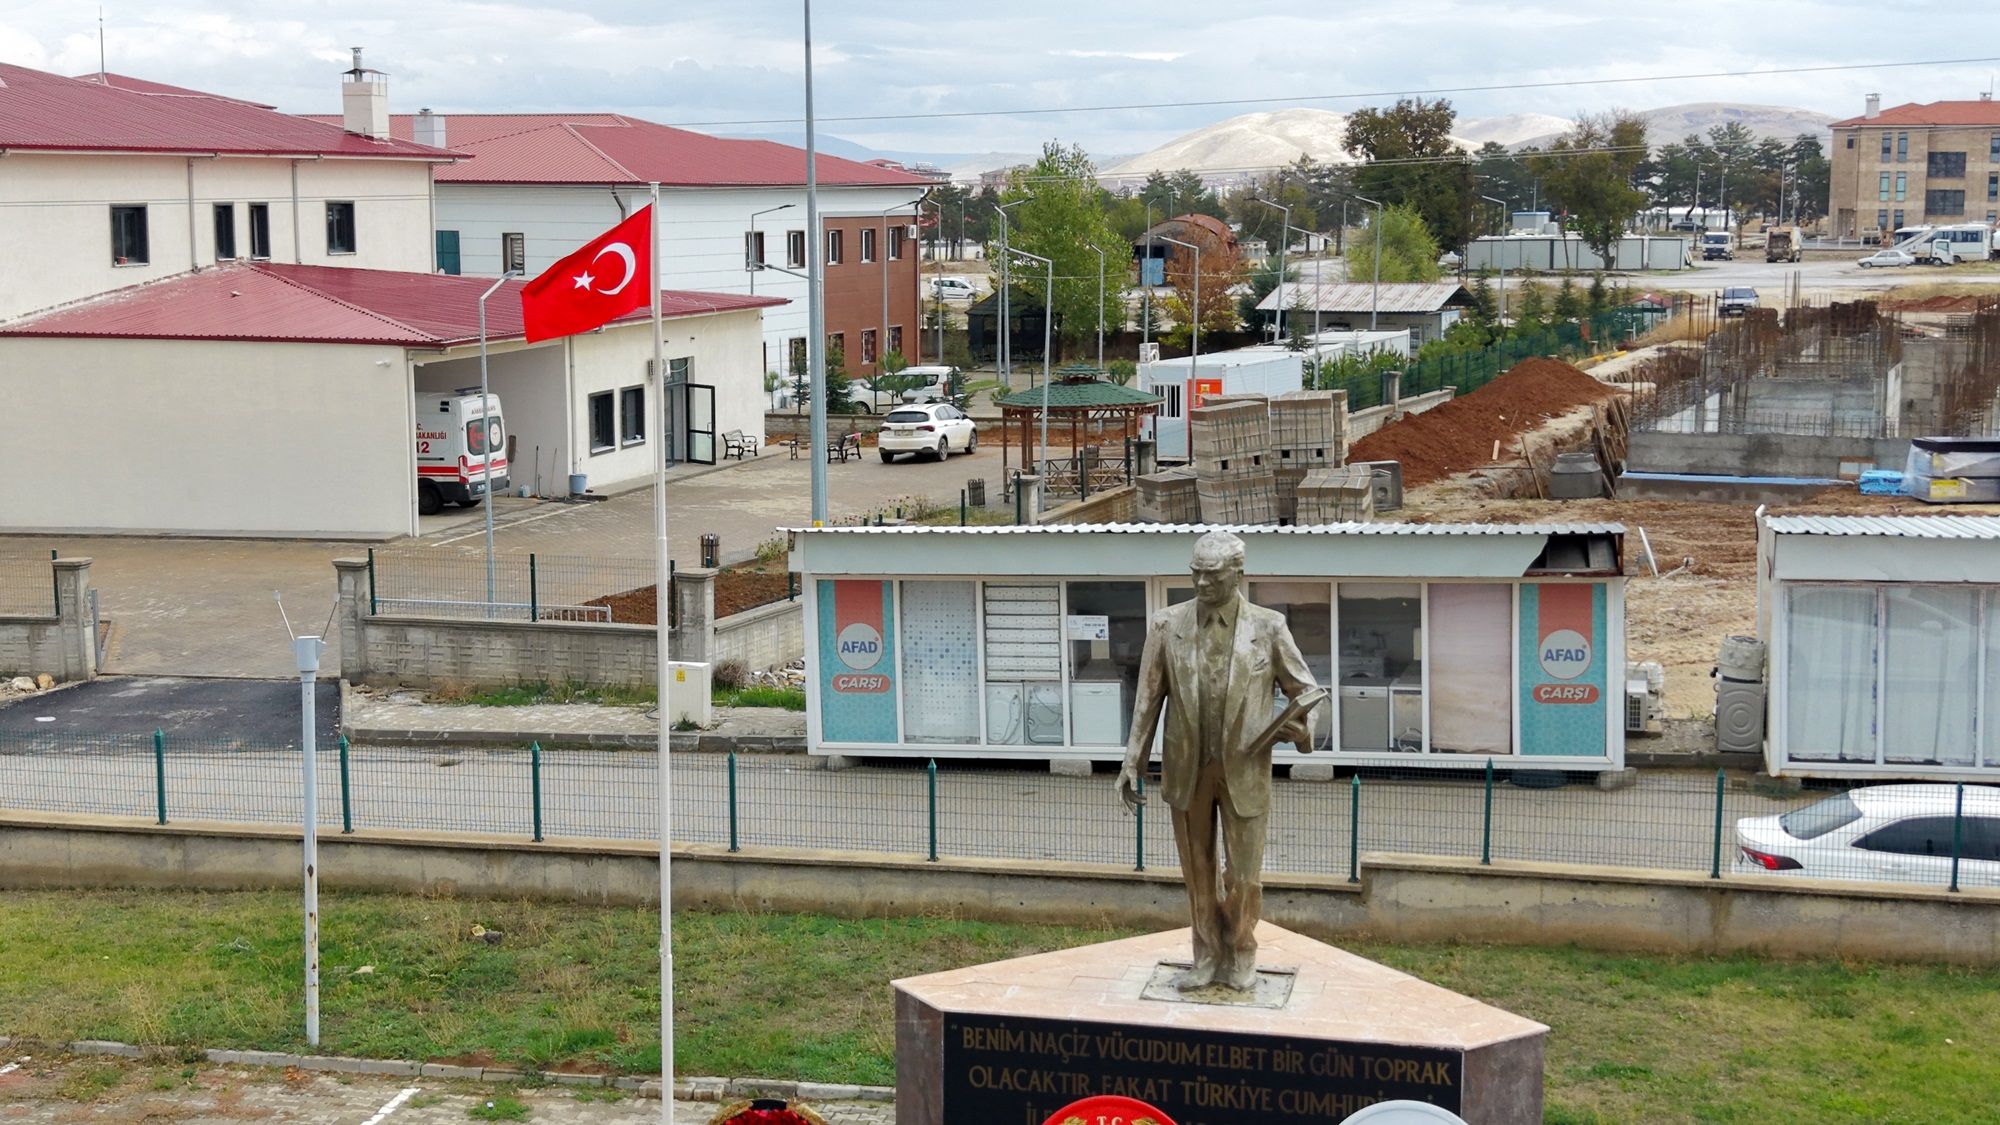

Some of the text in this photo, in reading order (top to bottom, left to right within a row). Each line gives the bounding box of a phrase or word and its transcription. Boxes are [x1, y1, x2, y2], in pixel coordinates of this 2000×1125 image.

[841, 640, 878, 654] AFAD
[1544, 648, 1586, 662] AFAD
[838, 676, 882, 690] ÇARŞI
[1540, 686, 1590, 701] ÇARŞI
[1030, 1027, 1090, 1064] NAÇİZ
[1096, 1031, 1201, 1067] VÜCUDUM
[1206, 1043, 1268, 1072] ELBET
[1273, 1043, 1305, 1075] BİR
[1309, 1047, 1354, 1079] GÜN
[1361, 1056, 1452, 1086] TOPRAK
[1102, 1075, 1172, 1102] FAKAT
[1180, 1075, 1274, 1112] TÜRKİYE
